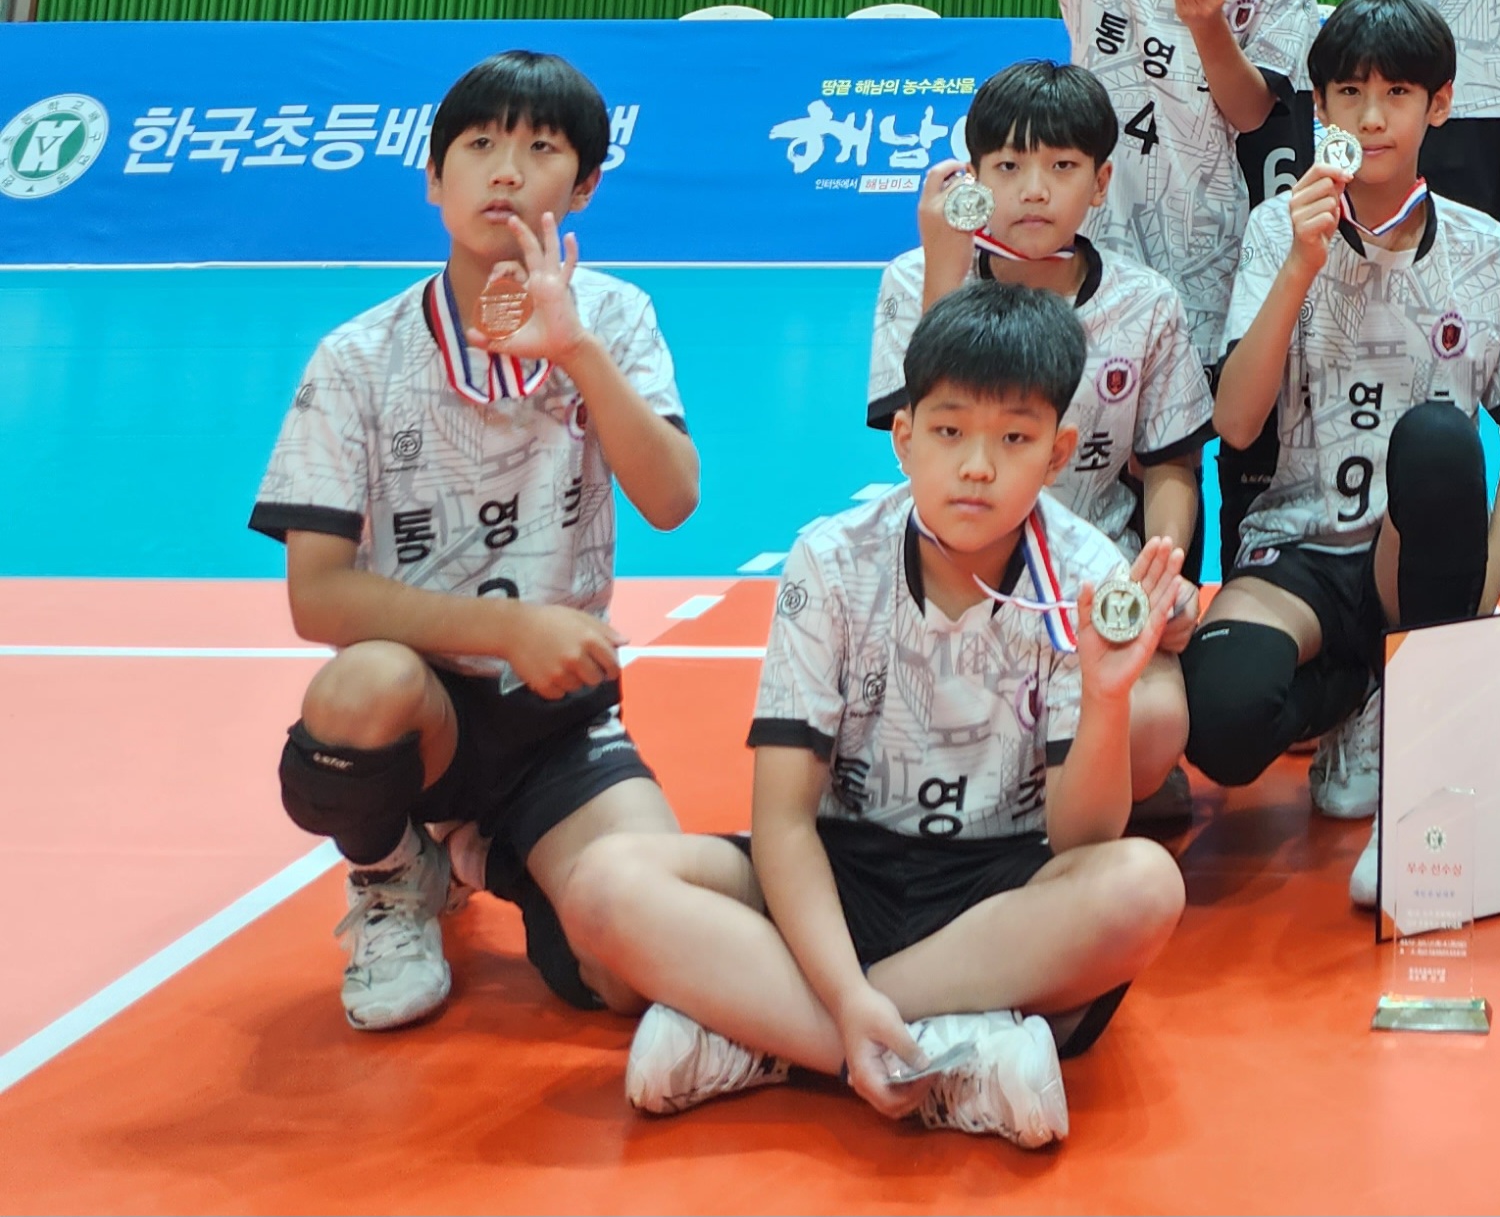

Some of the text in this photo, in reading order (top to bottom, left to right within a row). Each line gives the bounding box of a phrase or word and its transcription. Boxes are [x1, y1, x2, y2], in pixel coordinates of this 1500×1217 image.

[821, 78, 852, 96] 땅끝
[855, 78, 900, 96] 해남의
[1124, 100, 1161, 156] 4
[1336, 455, 1375, 523] 9
